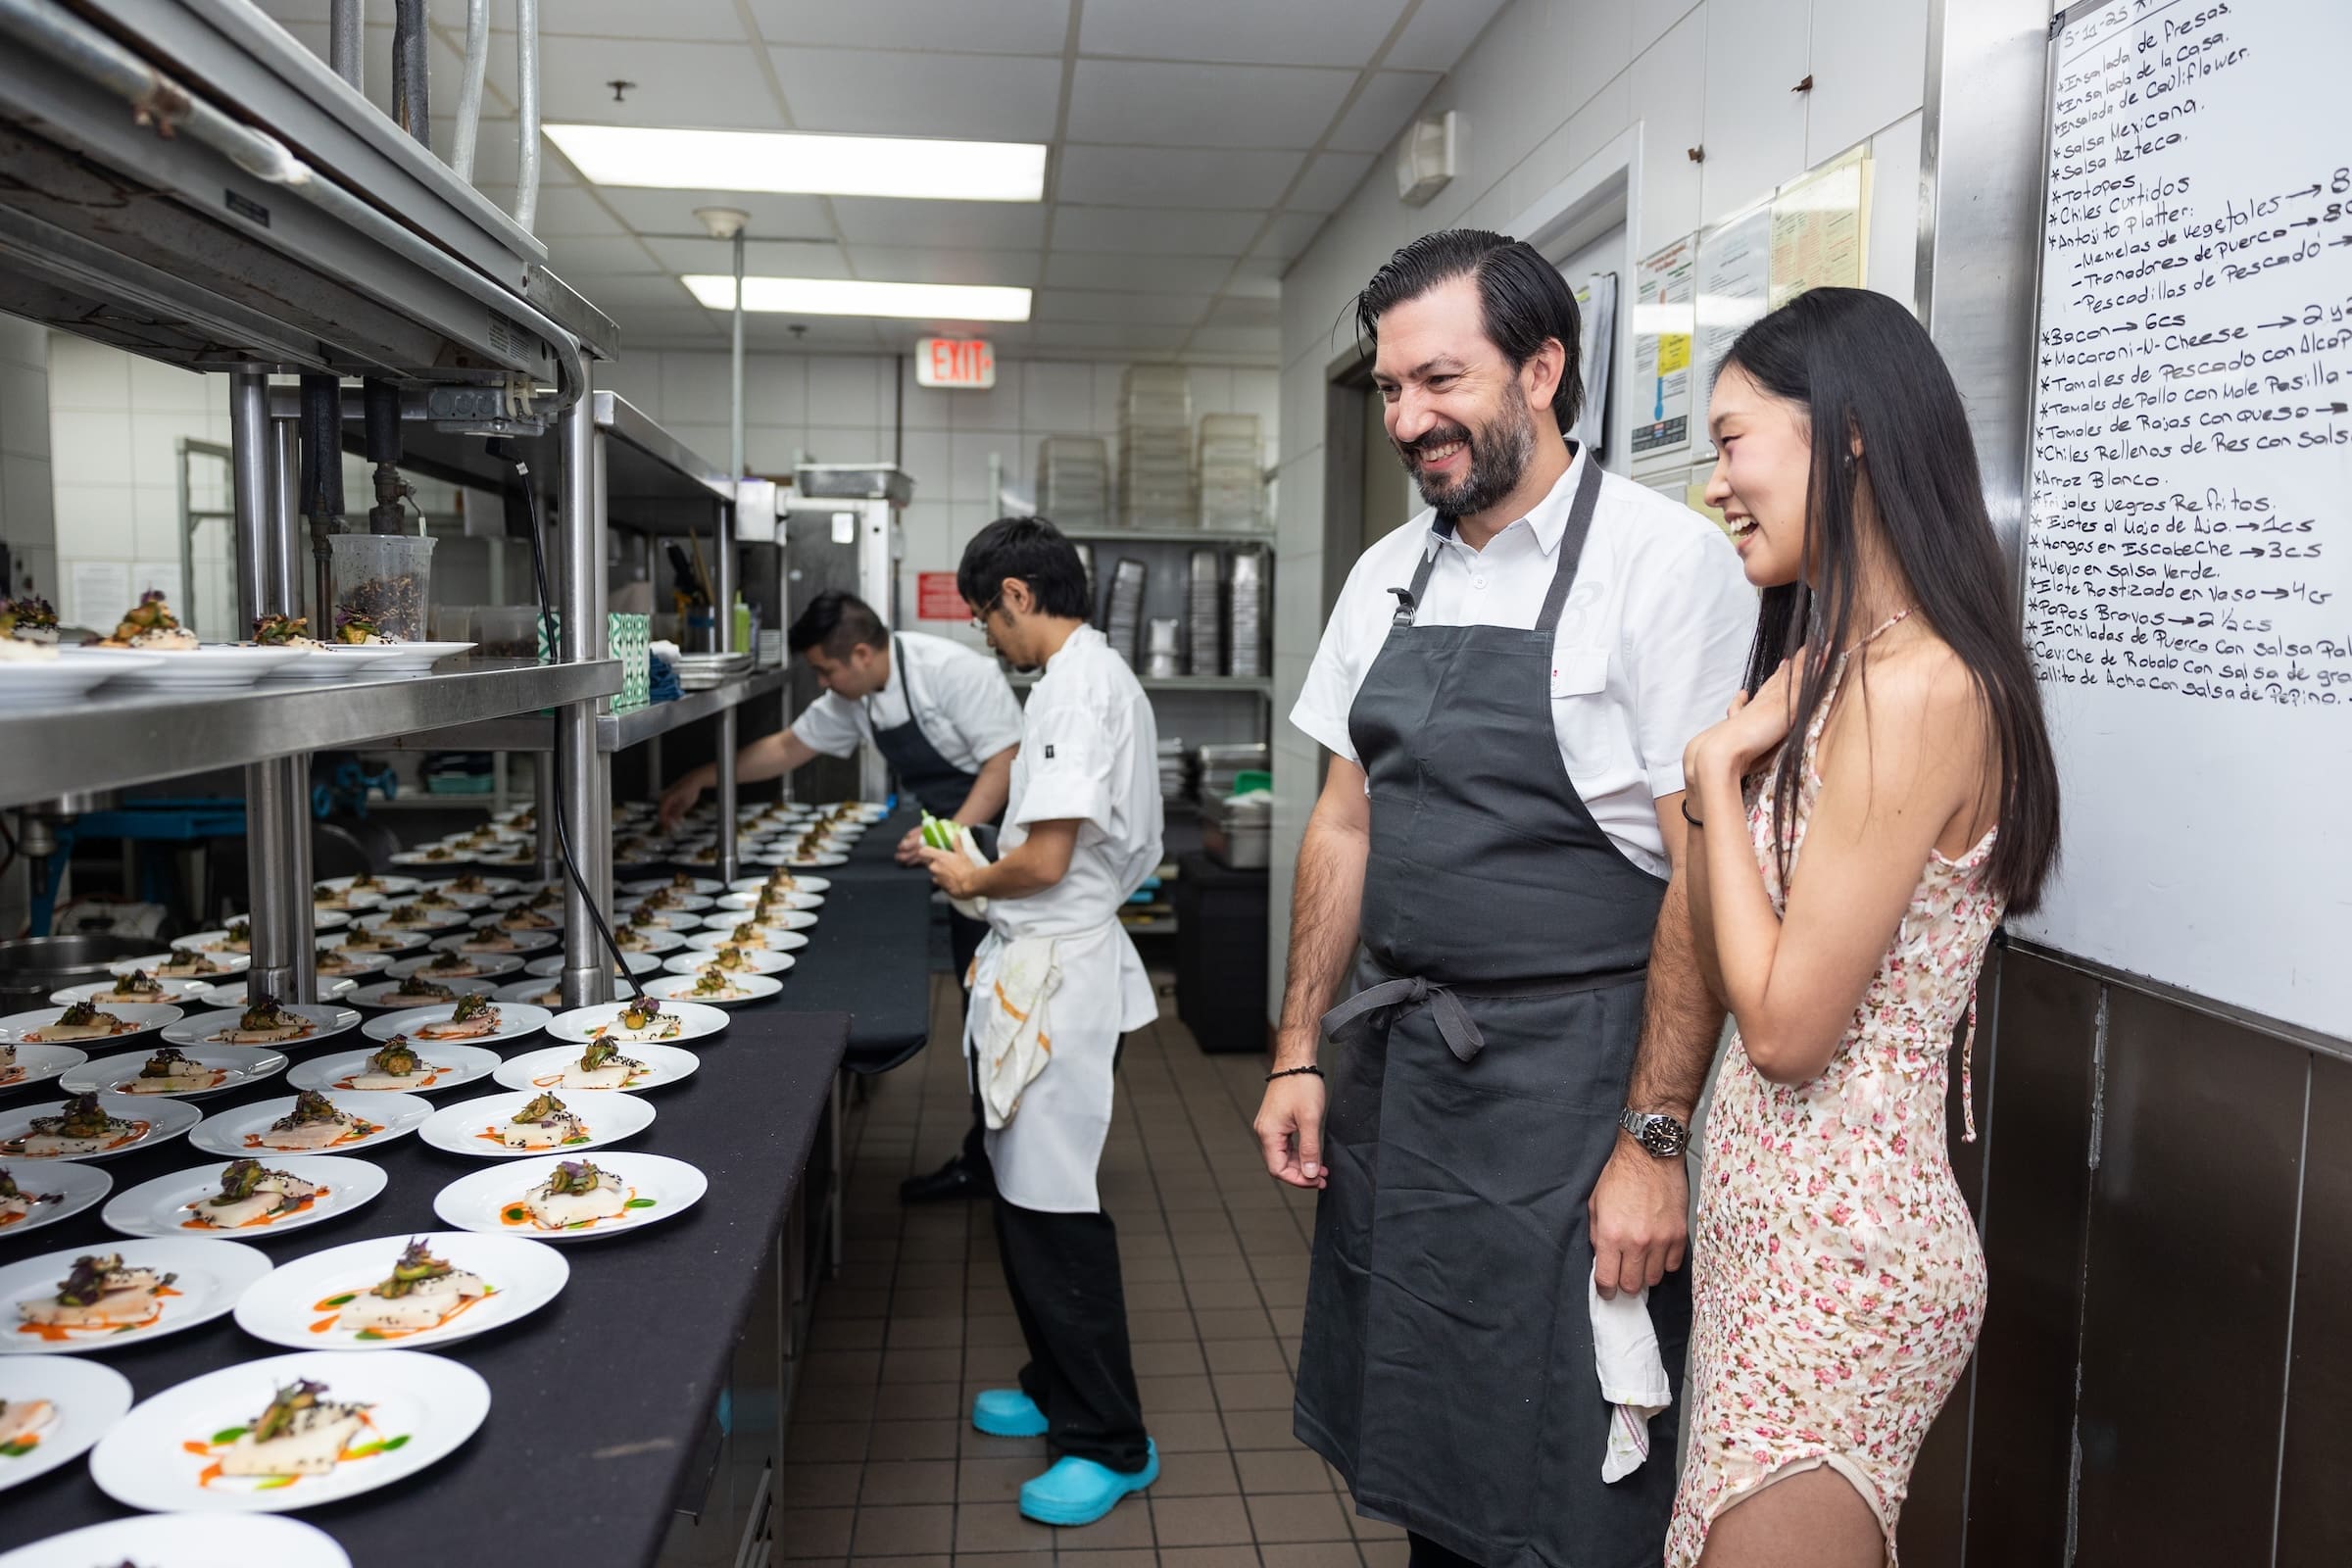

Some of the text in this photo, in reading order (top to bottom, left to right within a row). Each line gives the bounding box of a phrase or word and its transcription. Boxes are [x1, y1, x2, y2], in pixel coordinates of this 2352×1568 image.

[2064, 47, 2132, 92] Ensalada
[2137, 30, 2158, 54] de
[2063, 74, 2132, 115] Ensalada
[2136, 60, 2155, 80] de
[2160, 49, 2172, 68] la
[2060, 100, 2114, 138] Ensalada
[2119, 89, 2139, 110] de
[2063, 133, 2105, 160] Salsa
[2061, 154, 2107, 180] Salsa
[2060, 174, 2191, 224] Chiles Curtidos
[2058, 222, 2120, 251] Antojito
[2157, 230, 2177, 248] de
[2194, 244, 2211, 263] de
[2193, 270, 2217, 291] de
[2050, 325, 2110, 346] Bacon
[931, 339, 984, 382] EXIT
[2052, 368, 2125, 393] Tamales
[2131, 365, 2152, 384] de
[2158, 350, 2255, 381] Pescado
[2048, 396, 2106, 416] Tamales
[2112, 390, 2134, 410] de
[2134, 388, 2178, 409] Pollo
[2223, 379, 2258, 400] Mole
[2265, 361, 2339, 392] Pasilla
[2045, 420, 2102, 439] Tamales
[2110, 413, 2132, 432] de
[2135, 414, 2191, 432] Rajas
[2044, 444, 2089, 463] Chiles
[2095, 439, 2172, 461] Rellenos
[2180, 434, 2207, 455] de
[2211, 432, 2250, 452] Res
[2042, 470, 2082, 487] Arroz
[2104, 499, 2166, 516] Negros
[2046, 516, 2097, 533] Ejotes
[2104, 519, 2116, 533] al
[2124, 520, 2160, 537] Mojo
[2166, 516, 2186, 533] de
[2042, 539, 2093, 556] Hongos
[2098, 542, 2116, 555] en
[2083, 564, 2102, 576] en
[2036, 575, 2079, 594] Elote
[2083, 578, 2175, 598] Rostizado
[2180, 589, 2203, 601] en
[2095, 604, 2165, 626] Bravas
[2198, 612, 2214, 628] 2
[2131, 626, 2148, 644] de
[2153, 629, 2208, 653] Puerco
[2100, 648, 2118, 666] de
[2123, 651, 2179, 669] Robalo
[2286, 661, 2310, 681] de
[2081, 668, 2098, 684] de
[2107, 668, 2146, 688] Acha
[2240, 684, 2263, 702] de
